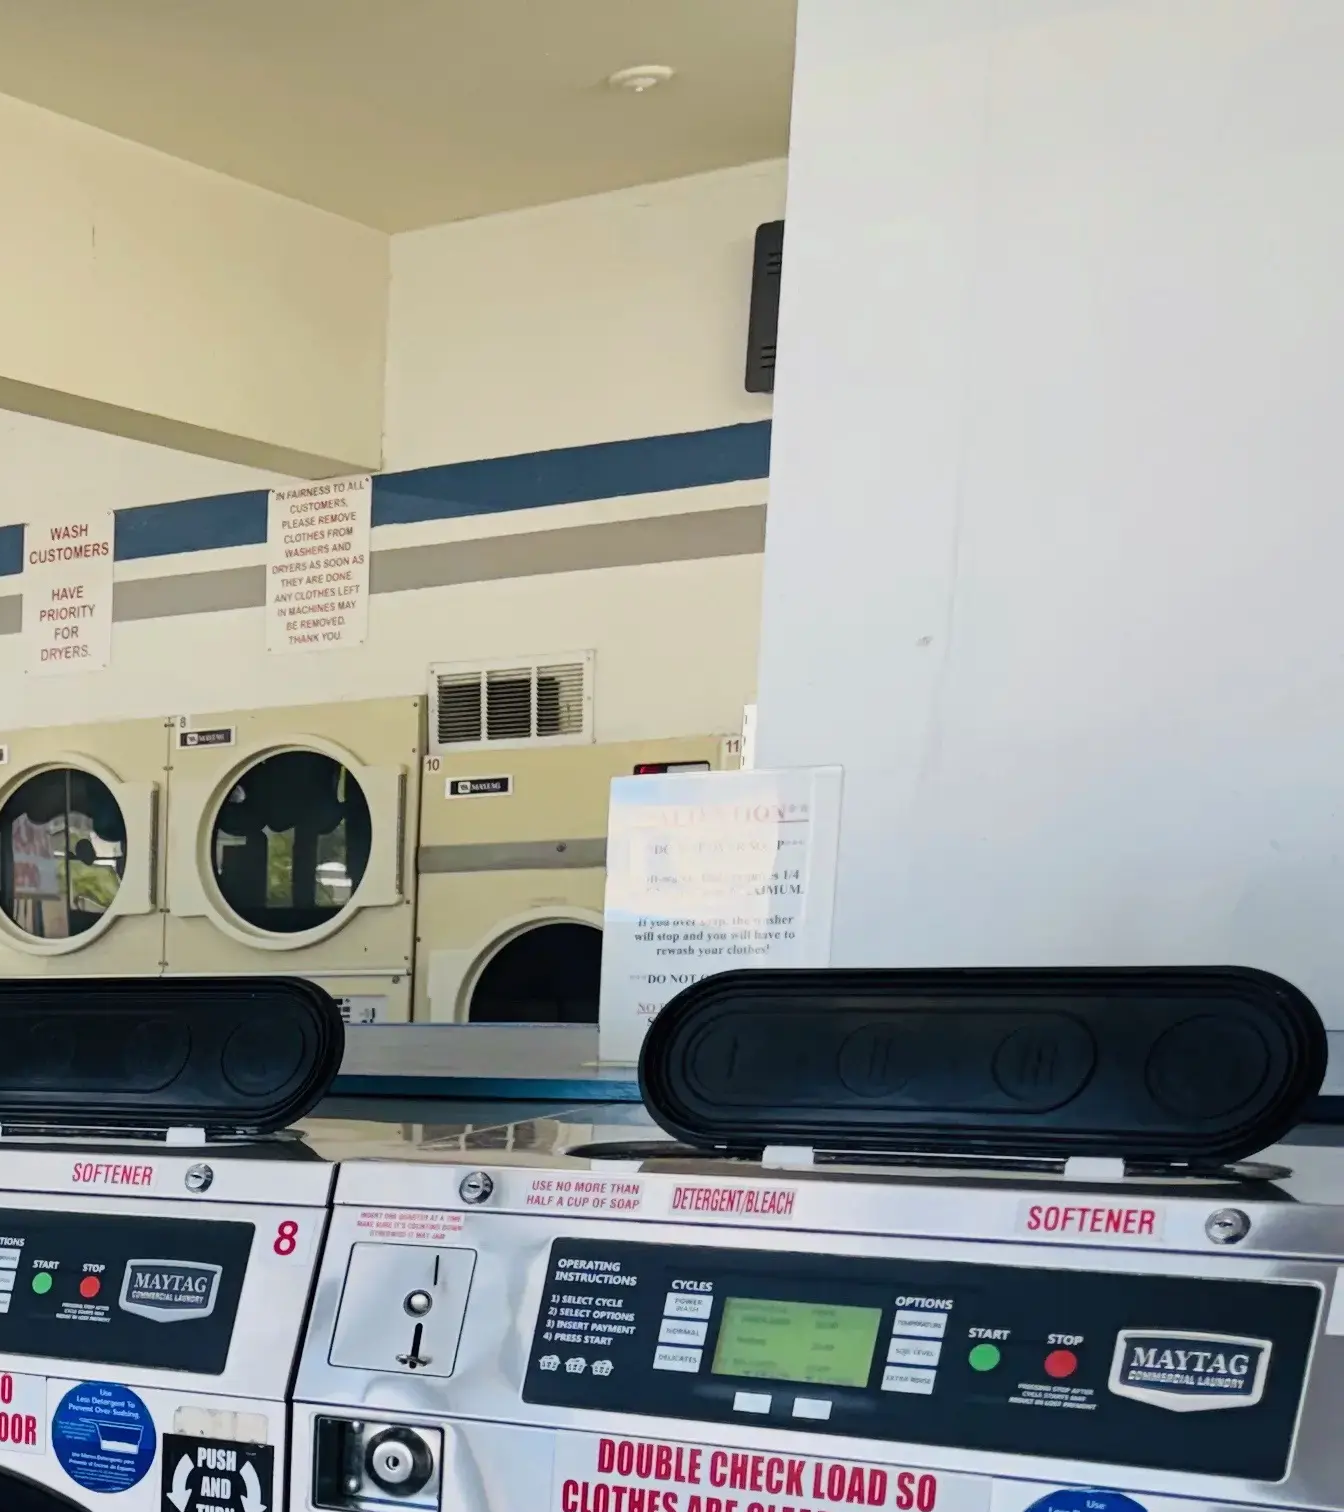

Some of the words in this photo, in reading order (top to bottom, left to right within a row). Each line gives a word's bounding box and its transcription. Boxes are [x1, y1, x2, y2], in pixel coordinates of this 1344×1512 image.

[282, 517, 316, 529] PLEASE
[318, 512, 356, 525] REMOVE
[50, 524, 89, 541] WASH
[284, 531, 325, 544] CLOTHES
[327, 527, 354, 538] FROM
[29, 542, 109, 565] CUSTOMERS
[285, 544, 329, 558] WASHERS
[331, 542, 351, 551] AND
[272, 561, 307, 574] DRYERS
[309, 561, 321, 569] AS
[323, 558, 349, 567] SOON
[352, 555, 364, 564] AS
[52, 586, 84, 601] HAVE
[274, 593, 292, 603] ANY
[294, 588, 335, 601] CLOTHES
[338, 585, 360, 595] LEFT
[40, 604, 96, 622] PRIORITY
[54, 625, 78, 641] FOR
[726, 740, 740, 753] 11
[425, 759, 440, 771] 10
[635, 933, 654, 941] will
[657, 933, 680, 943] stop
[683, 932, 703, 940] and
[706, 932, 727, 941] you
[784, 931, 795, 939] to
[72, 1163, 153, 1186] SOFTENER
[532, 1180, 553, 1192] USE
[556, 1181, 572, 1192] NO
[574, 1182, 608, 1193] MORE
[611, 1183, 639, 1195] THAN
[526, 1194, 554, 1206] HALF
[556, 1196, 564, 1206] A
[567, 1197, 590, 1208] CUP
[593, 1198, 607, 1208] OF
[610, 1198, 640, 1210] SOAP
[673, 1187, 794, 1215] DETERGENT/BLEACH
[1027, 1206, 1156, 1235] SOFTENER
[273, 1220, 299, 1256] 8
[33, 1260, 59, 1270] START
[83, 1264, 105, 1273] STOP
[558, 1258, 620, 1272] OPERATING
[134, 1273, 208, 1293] MAYTAG
[555, 1271, 637, 1287] INSTRUCTIONS
[672, 1280, 713, 1292] CYCLES
[551, 1294, 560, 1304] 1)
[562, 1295, 594, 1306] SELECT
[596, 1298, 624, 1308] CYCLE
[895, 1296, 954, 1310] OPTIONS
[548, 1307, 557, 1317] 2)
[560, 1308, 590, 1319] SELECT
[593, 1310, 634, 1322] OPTIONS
[546, 1320, 555, 1330] 3)
[557, 1320, 588, 1332] INSERT
[590, 1323, 635, 1335] PAYMENT
[968, 1328, 1011, 1341] START
[543, 1332, 552, 1342] 4)
[555, 1333, 581, 1344] PRESS
[584, 1335, 613, 1346] START
[1047, 1334, 1083, 1346] STOP
[1131, 1346, 1249, 1375] MAYTAG
[1128, 1370, 1195, 1386] COMMERCIAL
[1197, 1375, 1244, 1389] LAUNDRY
[197, 1447, 236, 1472] PUSH
[597, 1438, 703, 1484] DOUBLE
[709, 1450, 806, 1497] CHECK
[812, 1462, 887, 1506] LOAD
[896, 1472, 937, 1512] SO
[201, 1477, 231, 1499] AND
[1086, 1500, 1107, 1509] Use
